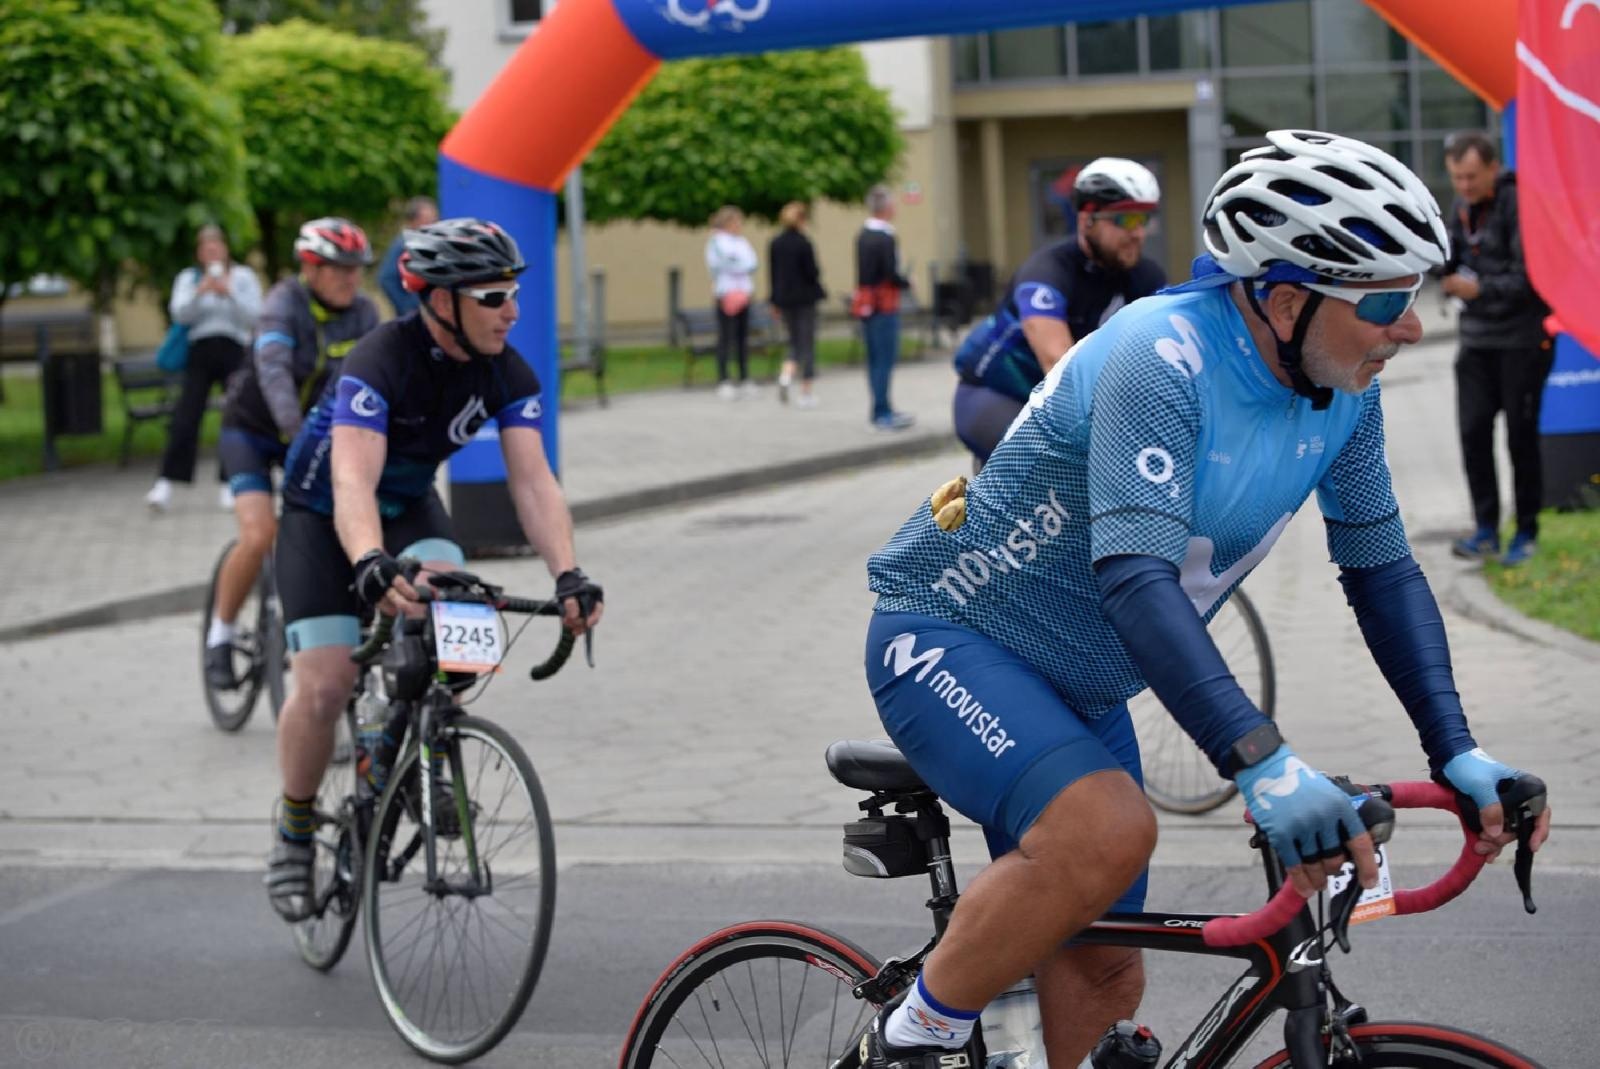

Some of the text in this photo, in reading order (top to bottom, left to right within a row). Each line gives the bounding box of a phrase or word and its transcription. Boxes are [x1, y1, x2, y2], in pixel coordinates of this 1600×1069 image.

[1308, 263, 1374, 280] LAZER
[440, 624, 495, 647] 2245
[927, 669, 1017, 758] movistar
